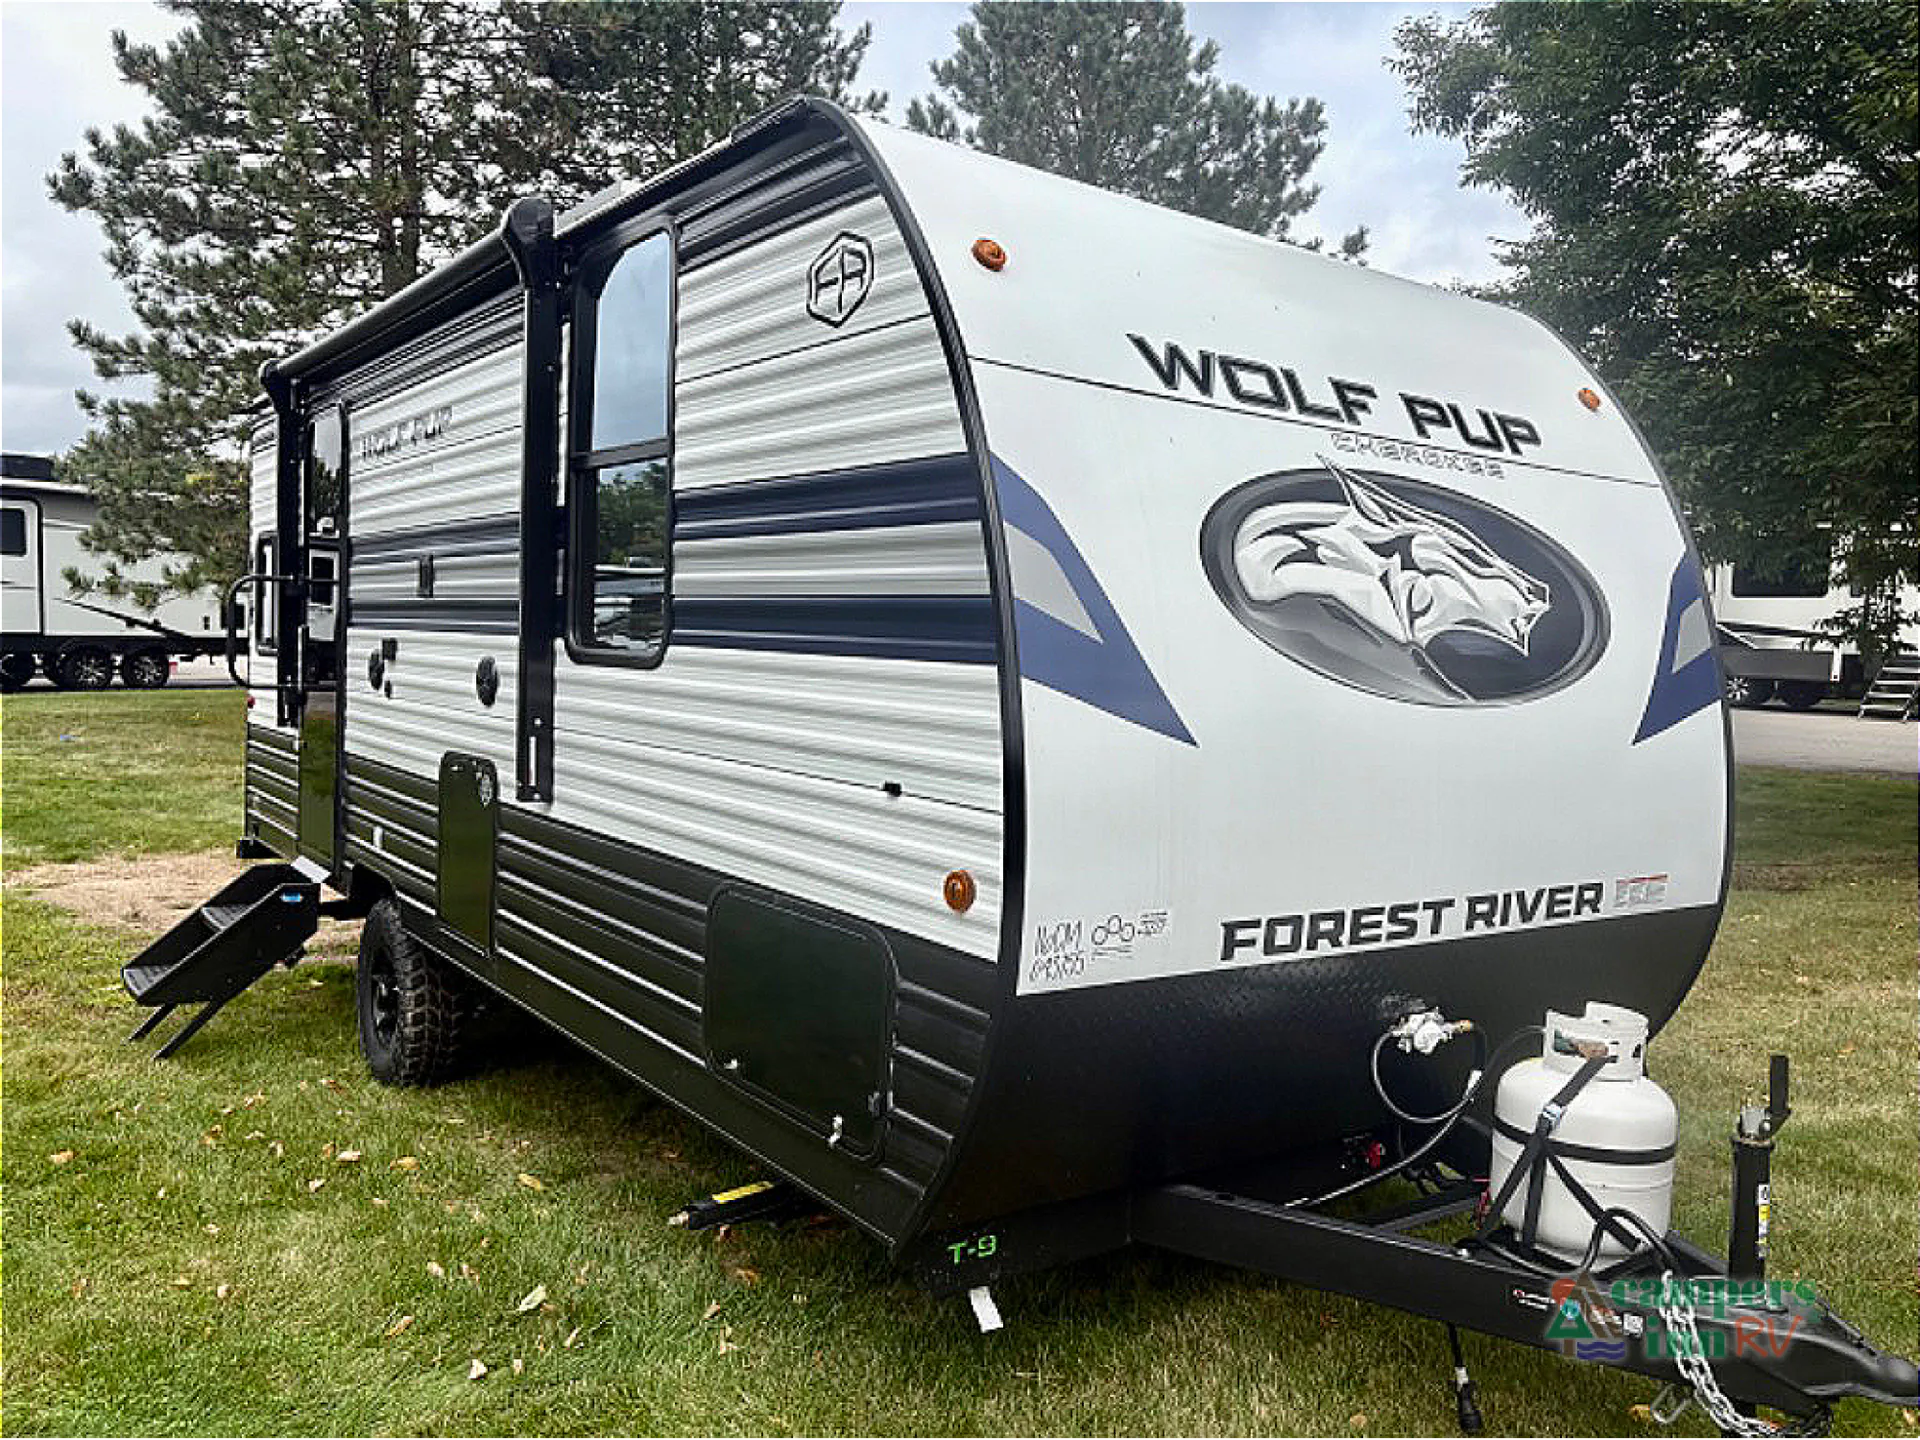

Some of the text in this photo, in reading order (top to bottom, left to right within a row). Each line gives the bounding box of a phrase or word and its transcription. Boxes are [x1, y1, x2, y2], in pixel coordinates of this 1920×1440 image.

[1125, 332, 1542, 457] WOLF PUP
[1330, 432, 1505, 480] CHEROKEE
[1219, 897, 1456, 961] FOREST
[1465, 881, 1604, 931] RIVER
[946, 1234, 997, 1265] T-9
